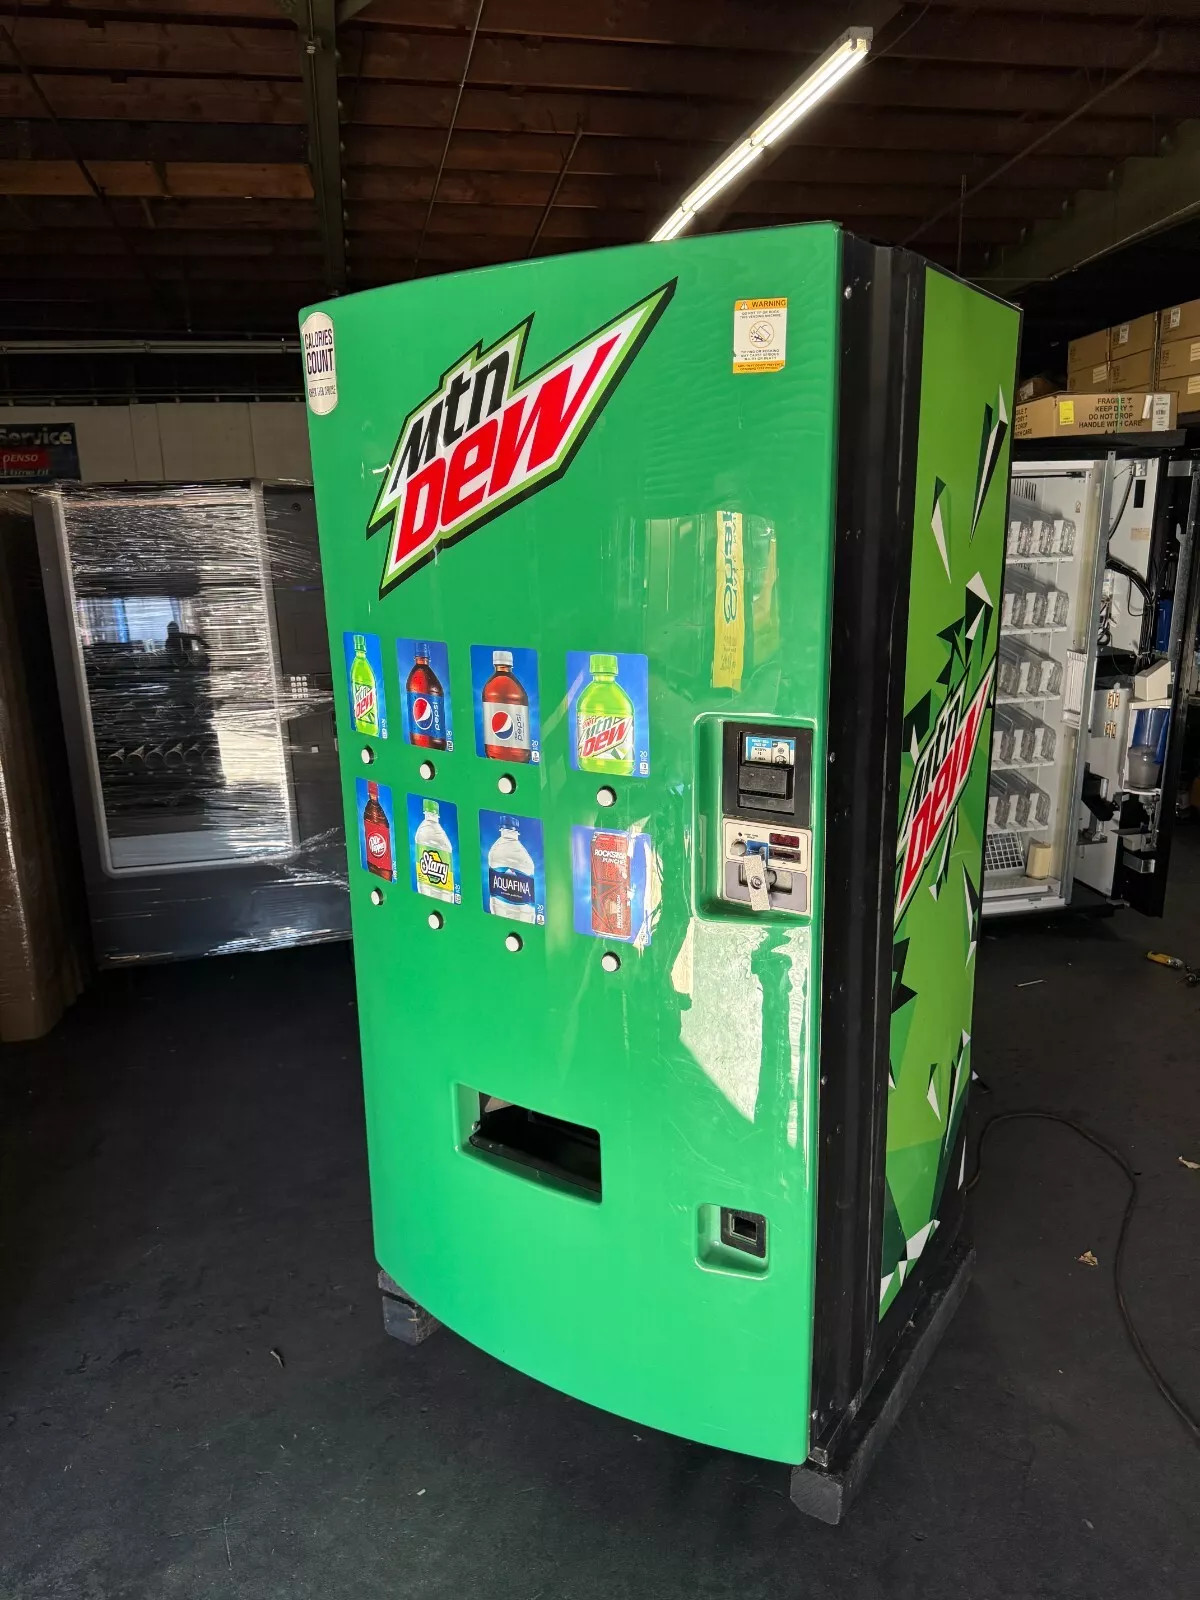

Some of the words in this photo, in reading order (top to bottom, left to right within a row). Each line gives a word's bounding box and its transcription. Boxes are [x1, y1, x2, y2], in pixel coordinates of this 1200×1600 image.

[751, 299, 787, 308] WARNING
[304, 328, 333, 350] CALORIES
[1095, 404, 1113, 412] KEEP
[390, 350, 510, 494] Mtn
[1078, 420, 1105, 428] HANDLE
[1124, 419, 1143, 427] CARE
[1088, 413, 1099, 421] DO
[3, 454, 39, 463] DENSO
[431, 701, 441, 731] pepsi
[420, 851, 449, 884] Starry
[493, 875, 531, 896] AQUAFINA
